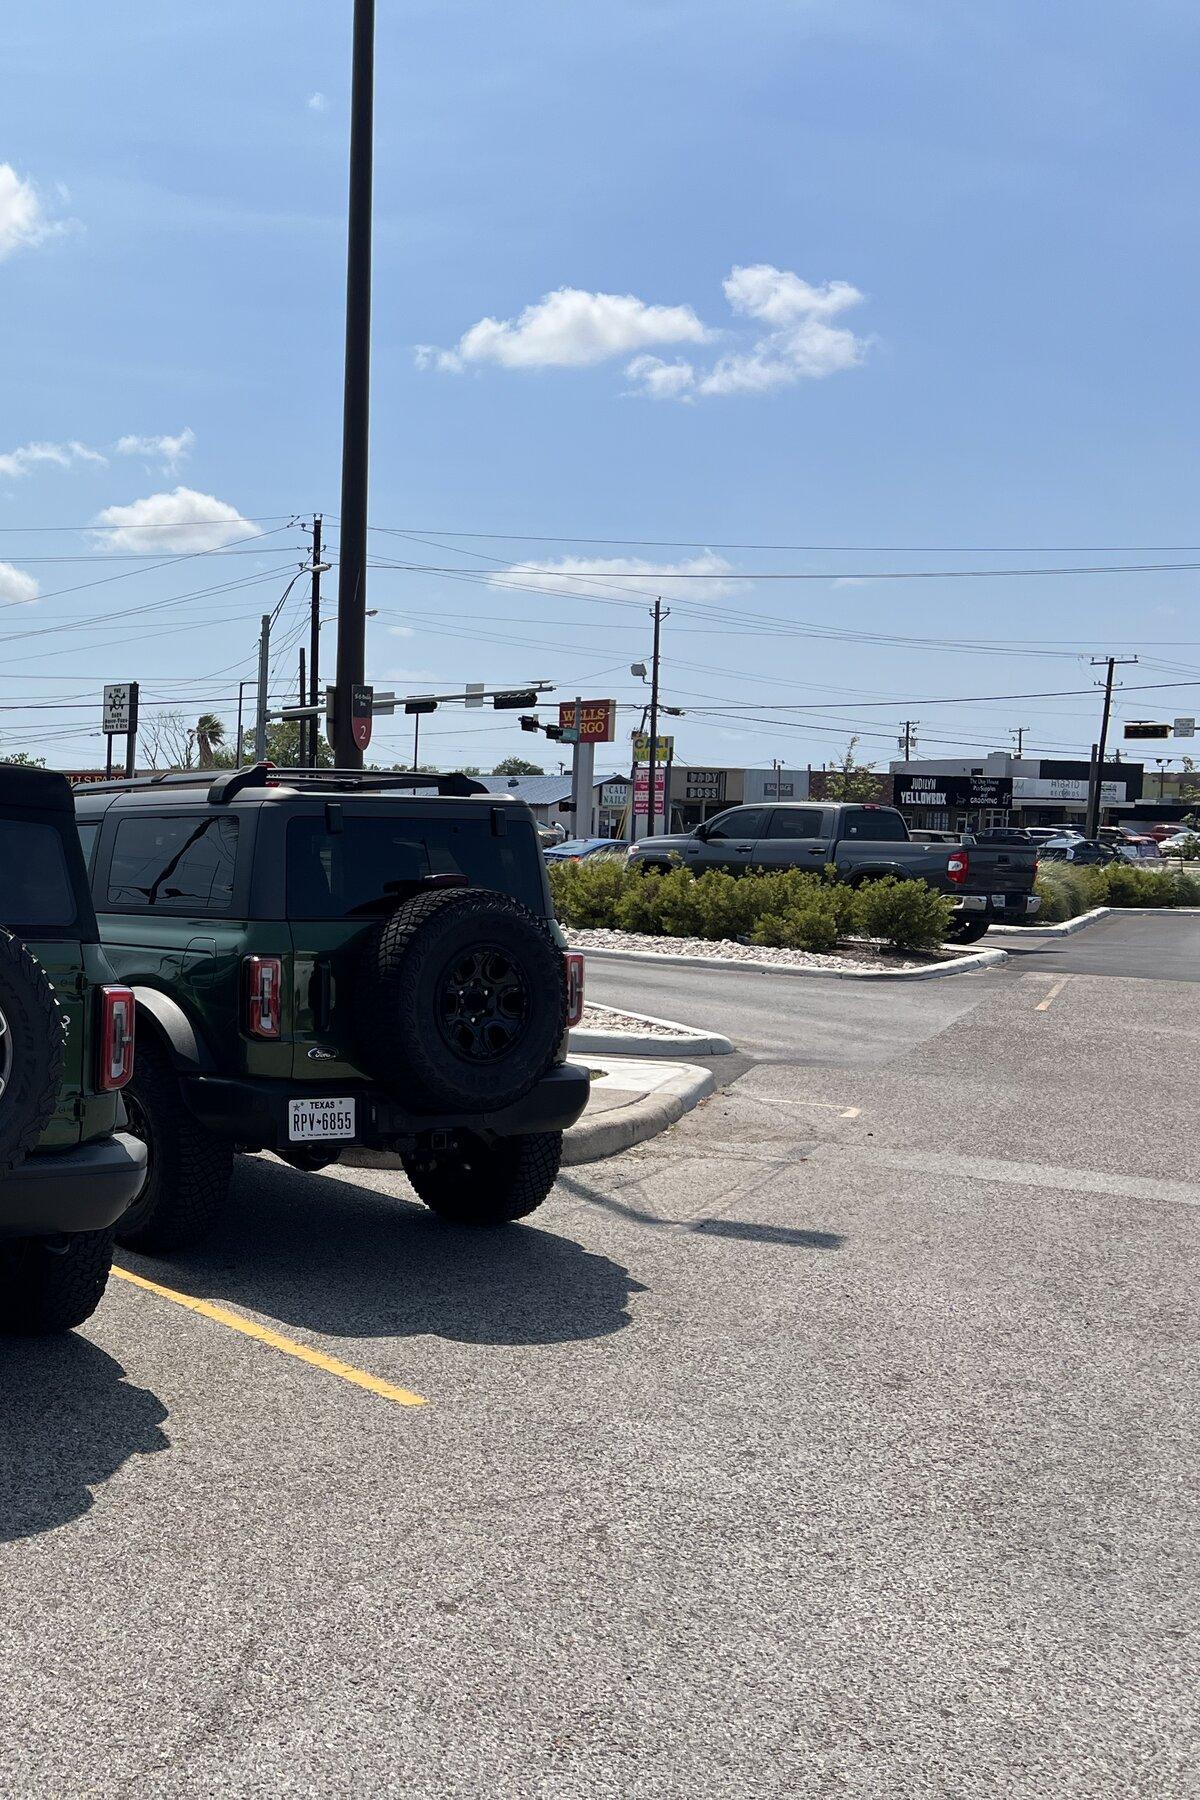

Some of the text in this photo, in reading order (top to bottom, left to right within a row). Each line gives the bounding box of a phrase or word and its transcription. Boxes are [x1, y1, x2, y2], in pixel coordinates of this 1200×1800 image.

[360, 725, 367, 740] 2
[563, 722, 605, 734] RGO
[609, 785, 627, 794] CALI
[690, 788, 717, 798] BOSS
[603, 796, 627, 804] NAILS
[901, 792, 947, 804] YELLOWBOX
[310, 1101, 335, 1109] TEXAS
